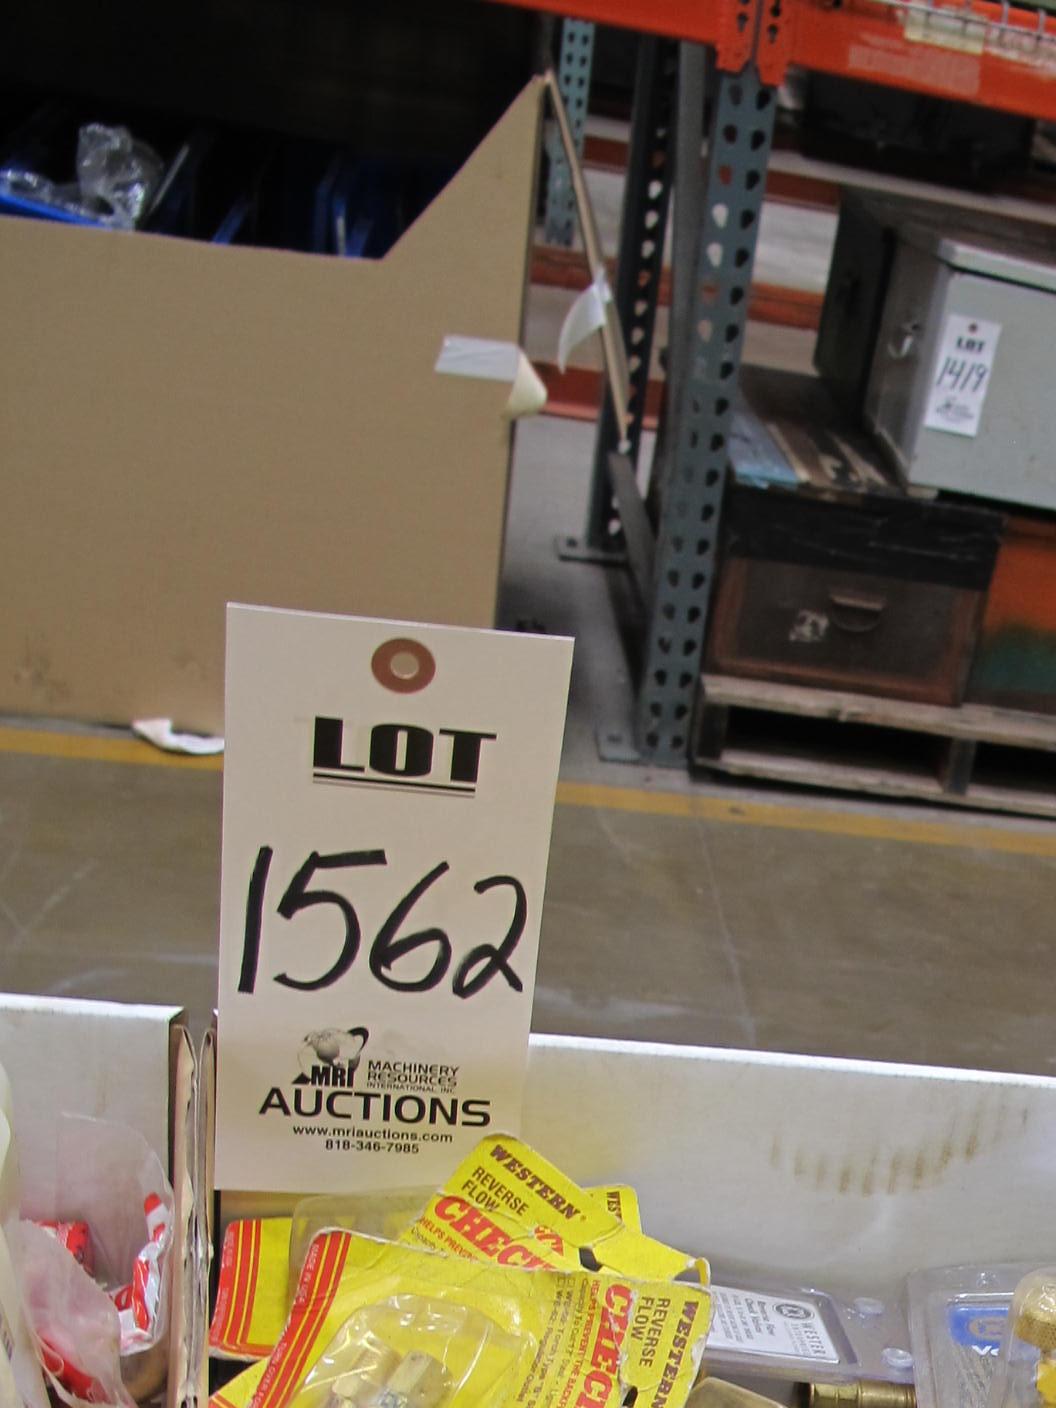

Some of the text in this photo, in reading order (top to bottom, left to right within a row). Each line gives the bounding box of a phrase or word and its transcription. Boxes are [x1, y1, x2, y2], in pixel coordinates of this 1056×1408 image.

[956, 336, 985, 352] LOT
[936, 357, 988, 392] 1419
[314, 717, 497, 782] LOT
[238, 845, 527, 999] 1562
[311, 1060, 459, 1087] MRI MACHINERY
[368, 1071, 457, 1087] RESOURCES
[259, 1087, 491, 1127] AUCTIONS
[293, 1125, 452, 1143] www.mriauctions.com
[326, 1140, 419, 1154] 818-346-7985
[463, 1180, 500, 1212] FLOW
[473, 1167, 528, 1216] REVERSE
[490, 1145, 581, 1219] WESTERN
[435, 1196, 556, 1270] CHEC
[631, 1296, 654, 1341] FLOW
[639, 1298, 670, 1368] REVERSE
